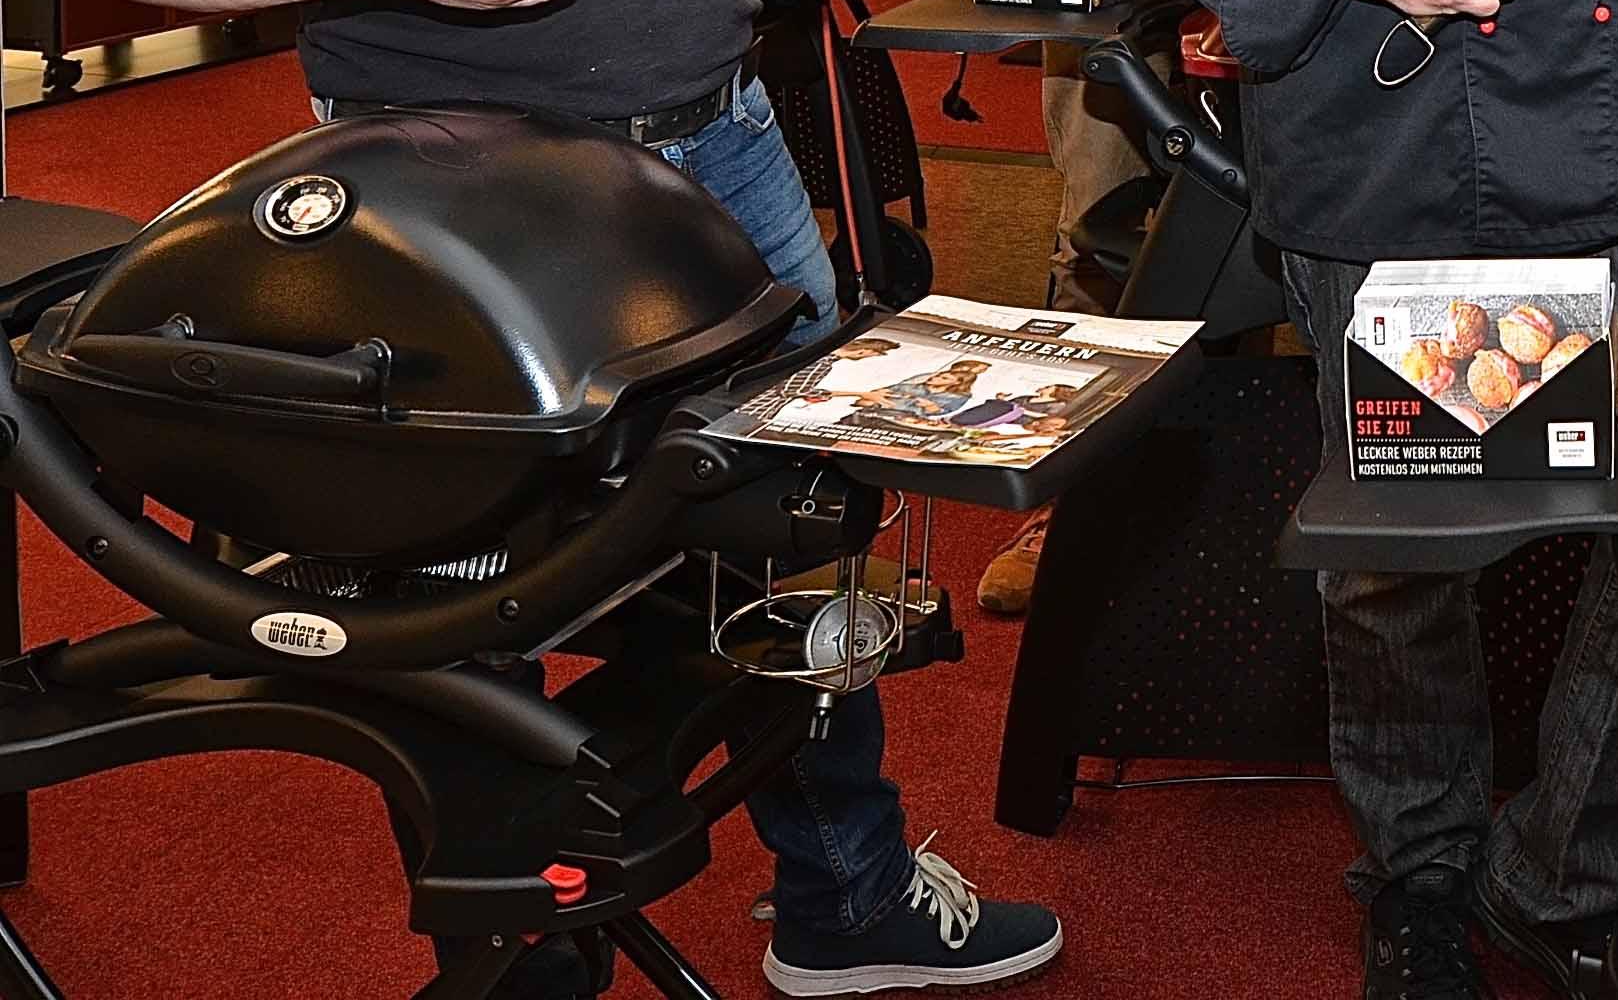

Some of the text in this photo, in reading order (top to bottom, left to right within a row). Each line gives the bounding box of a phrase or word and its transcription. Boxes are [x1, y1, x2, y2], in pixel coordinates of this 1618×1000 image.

[941, 330, 1101, 360] ANFEUERN
[1356, 401, 1421, 416] GREIFEN
[1357, 420, 1411, 435] SIE ZU!
[1358, 446, 1482, 460] LECKERE WEBER REZEPTE
[1359, 463, 1483, 476] KOSTENLOS ZUM MITNEHMEN
